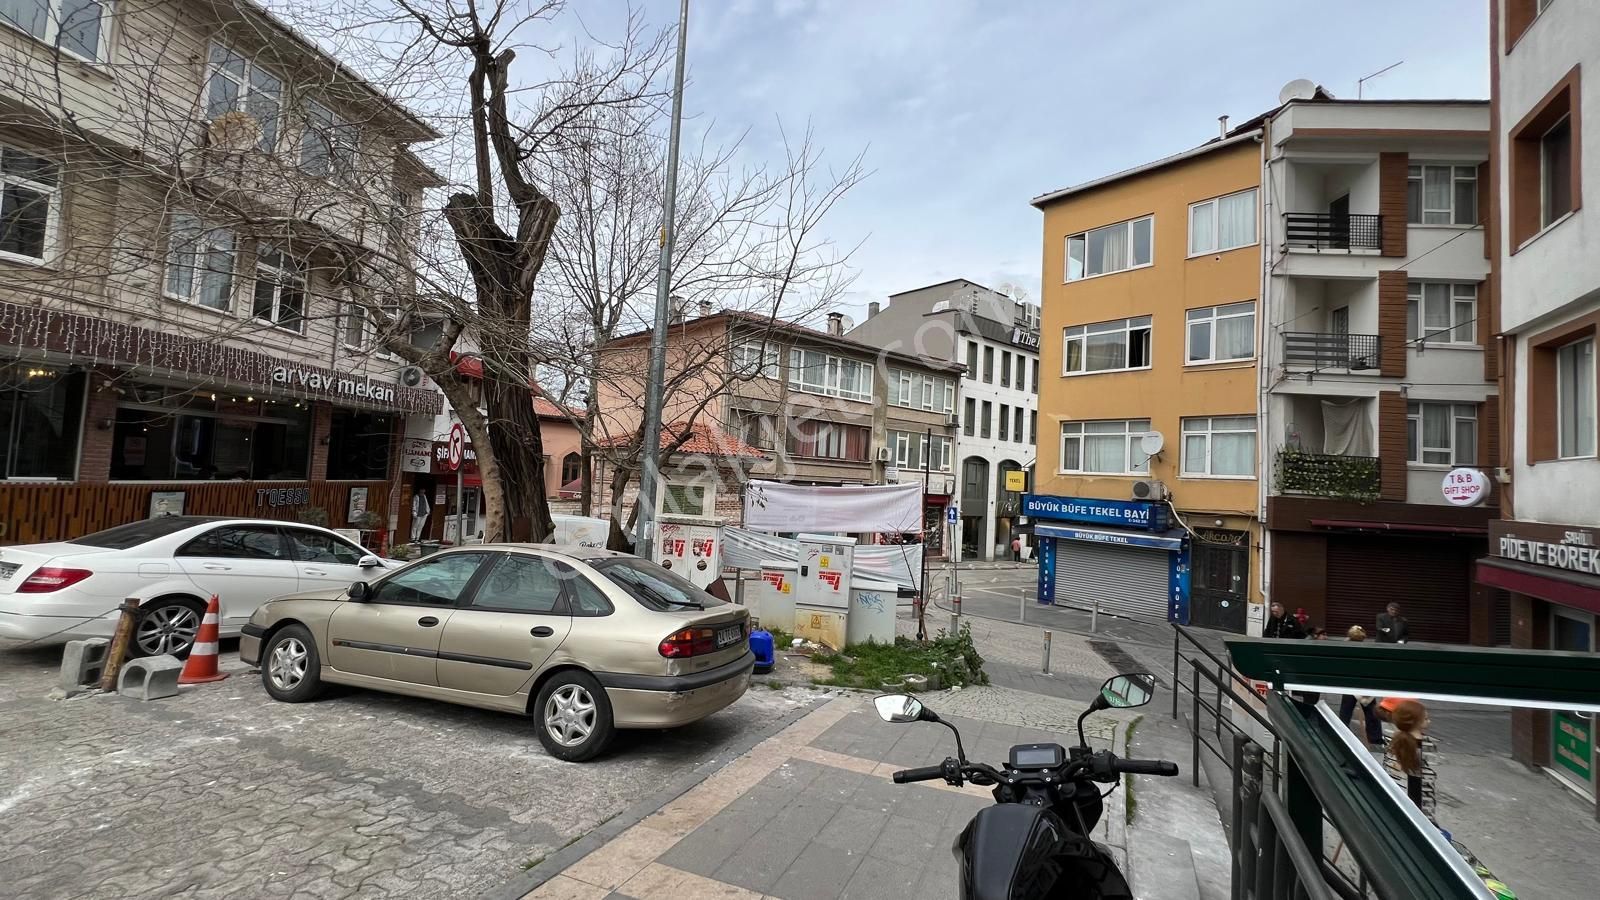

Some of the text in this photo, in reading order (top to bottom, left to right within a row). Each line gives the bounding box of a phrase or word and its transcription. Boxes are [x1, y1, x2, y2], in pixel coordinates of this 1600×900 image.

[1021, 331, 1036, 346] The
[337, 375, 394, 402] mekan
[1449, 473, 1473, 483] T & B
[1443, 485, 1480, 495] GIFT SHOP
[1028, 501, 1149, 519] BÜYÜK BÜFE TEKEL BAYİ
[1074, 532, 1094, 540] BÜYÜK
[1110, 536, 1129, 544] TEKEL
[1500, 533, 1600, 575] PİDE VE BÖREK
